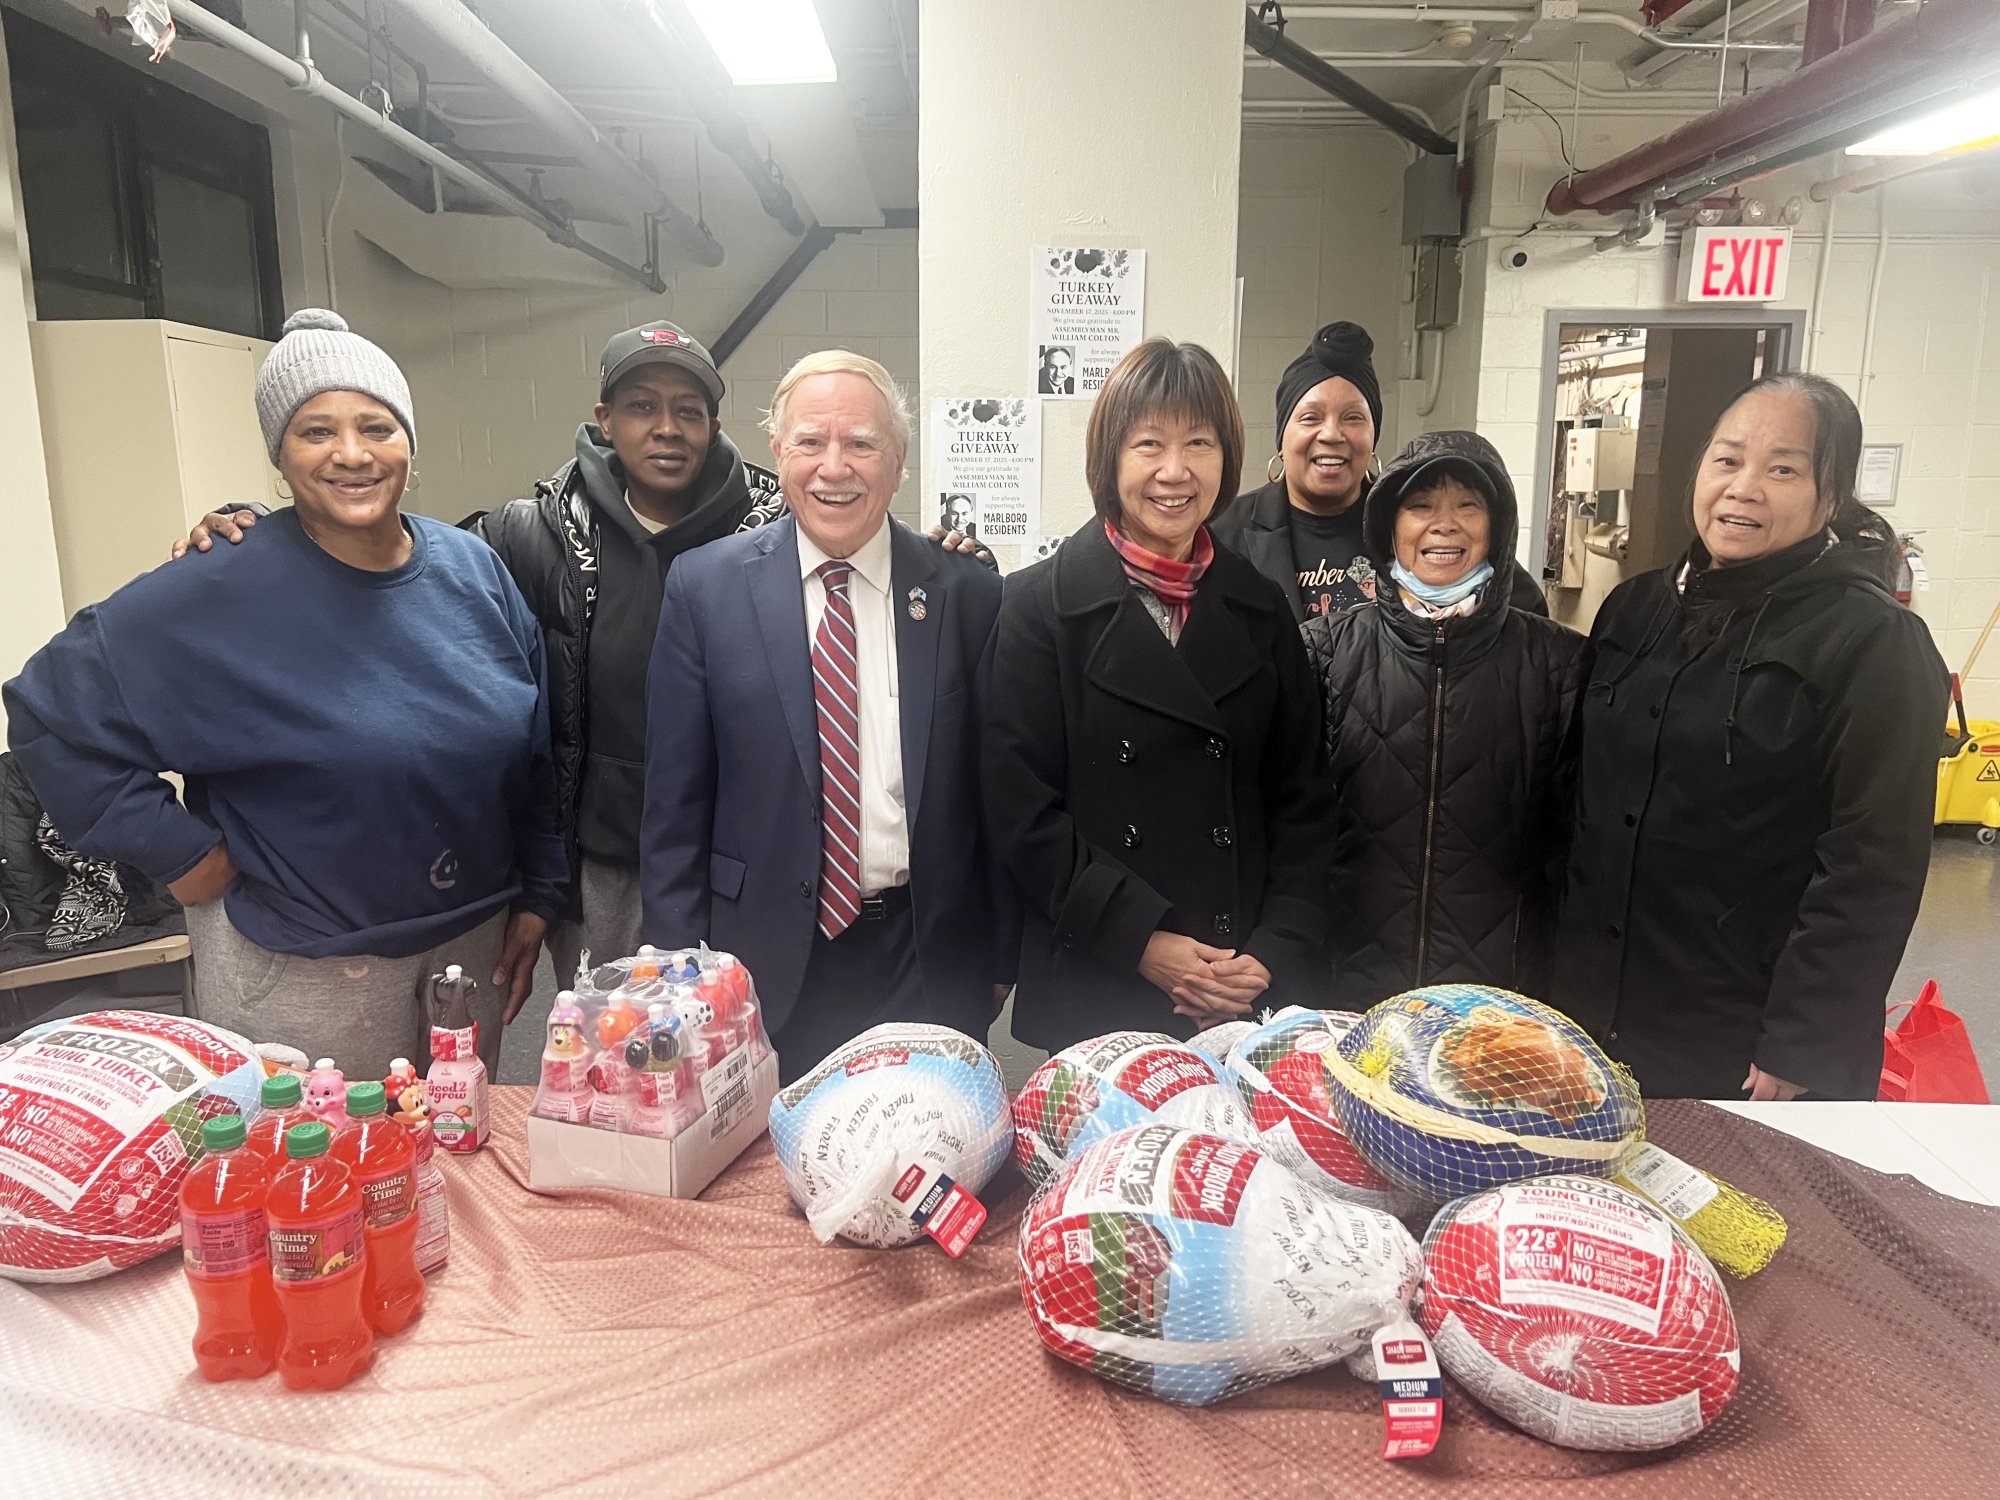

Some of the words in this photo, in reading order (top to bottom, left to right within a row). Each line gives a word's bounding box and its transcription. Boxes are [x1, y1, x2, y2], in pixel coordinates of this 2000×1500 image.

[1702, 238, 1784, 296] EXIT
[1052, 294, 1121, 305] GIVEAWAY
[1058, 282, 1114, 293] TURKEY
[950, 443, 1020, 454] GIVEAWAY
[958, 432, 1012, 442] TURKEY
[984, 512, 1027, 523] MARLBORO
[984, 525, 1026, 534] RESIDENTS
[1296, 559, 1346, 587] mber
[63, 1033, 177, 1074] FROZEN
[169, 1023, 237, 1059] BROOK
[35, 1046, 90, 1064] YOUNG
[91, 1056, 163, 1092] TURKEY
[1145, 1055, 1179, 1072] FARMS
[14, 1073, 79, 1094] INDEPENDENT
[78, 1087, 111, 1110] FARMS
[1136, 1067, 1180, 1100] BROOK
[434, 1092, 466, 1104] grow
[22, 1104, 50, 1124] NO
[846, 1093, 880, 1136] FROZEN
[4, 1126, 33, 1146] NO
[817, 1116, 841, 1162] FROZEN
[152, 1140, 176, 1170] USA
[1126, 1127, 1172, 1184] FROZEN
[1190, 1146, 1214, 1177] FARMS
[362, 1174, 408, 1194] Country
[1098, 1151, 1126, 1194] TURKEY
[372, 1186, 402, 1202] Time
[918, 1184, 943, 1214] MEDIUM
[1200, 1162, 1234, 1214] BROOK
[1532, 1178, 1643, 1211] FROZEN
[1520, 1188, 1580, 1202] YOUNG
[1587, 1196, 1652, 1223] TURKEY
[270, 1230, 318, 1244] Country
[1348, 1219, 1368, 1250] FROZEN
[1516, 1228, 1557, 1251] 22g
[1536, 1212, 1600, 1231] INDEPENDENT
[1602, 1226, 1634, 1240] FARMS
[277, 1242, 308, 1252] Time
[1067, 1232, 1080, 1260] USA
[1510, 1251, 1563, 1271] PROTEIN
[1573, 1241, 1595, 1260] NO
[1571, 1262, 1593, 1282] NO
[1273, 1278, 1318, 1320] FROZEN
[1392, 1381, 1428, 1393] MEDIUM
